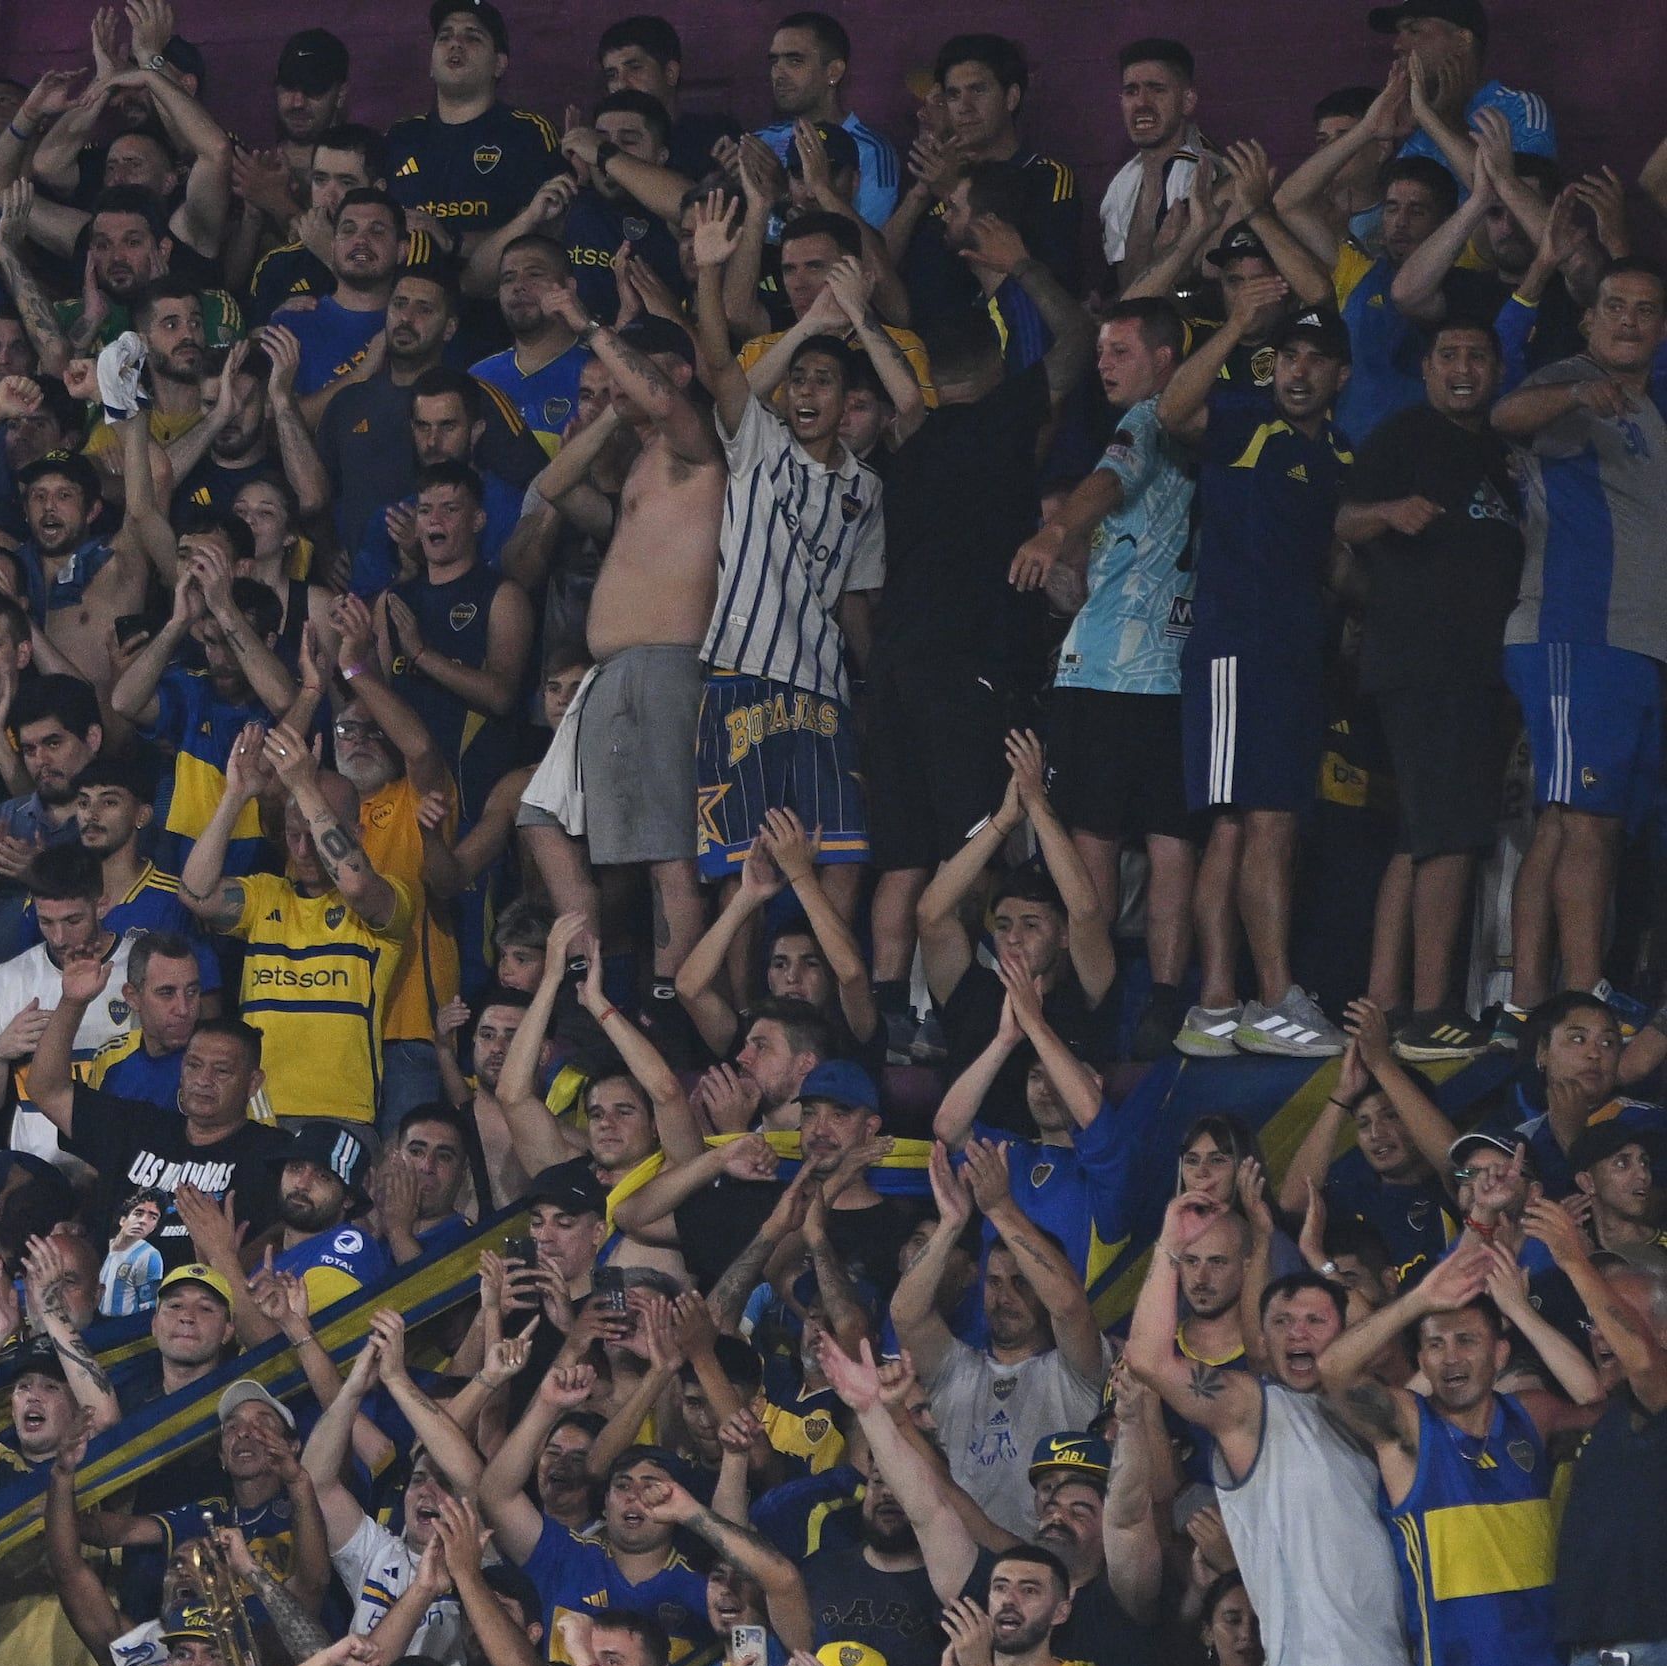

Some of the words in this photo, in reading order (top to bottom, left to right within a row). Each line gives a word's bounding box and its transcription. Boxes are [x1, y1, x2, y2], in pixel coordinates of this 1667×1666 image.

[415, 200, 488, 217] tsson
[128, 1150, 165, 1188] LAS
[320, 1254, 355, 1275] TOTAL
[1054, 1450, 1087, 1464] CABJ
